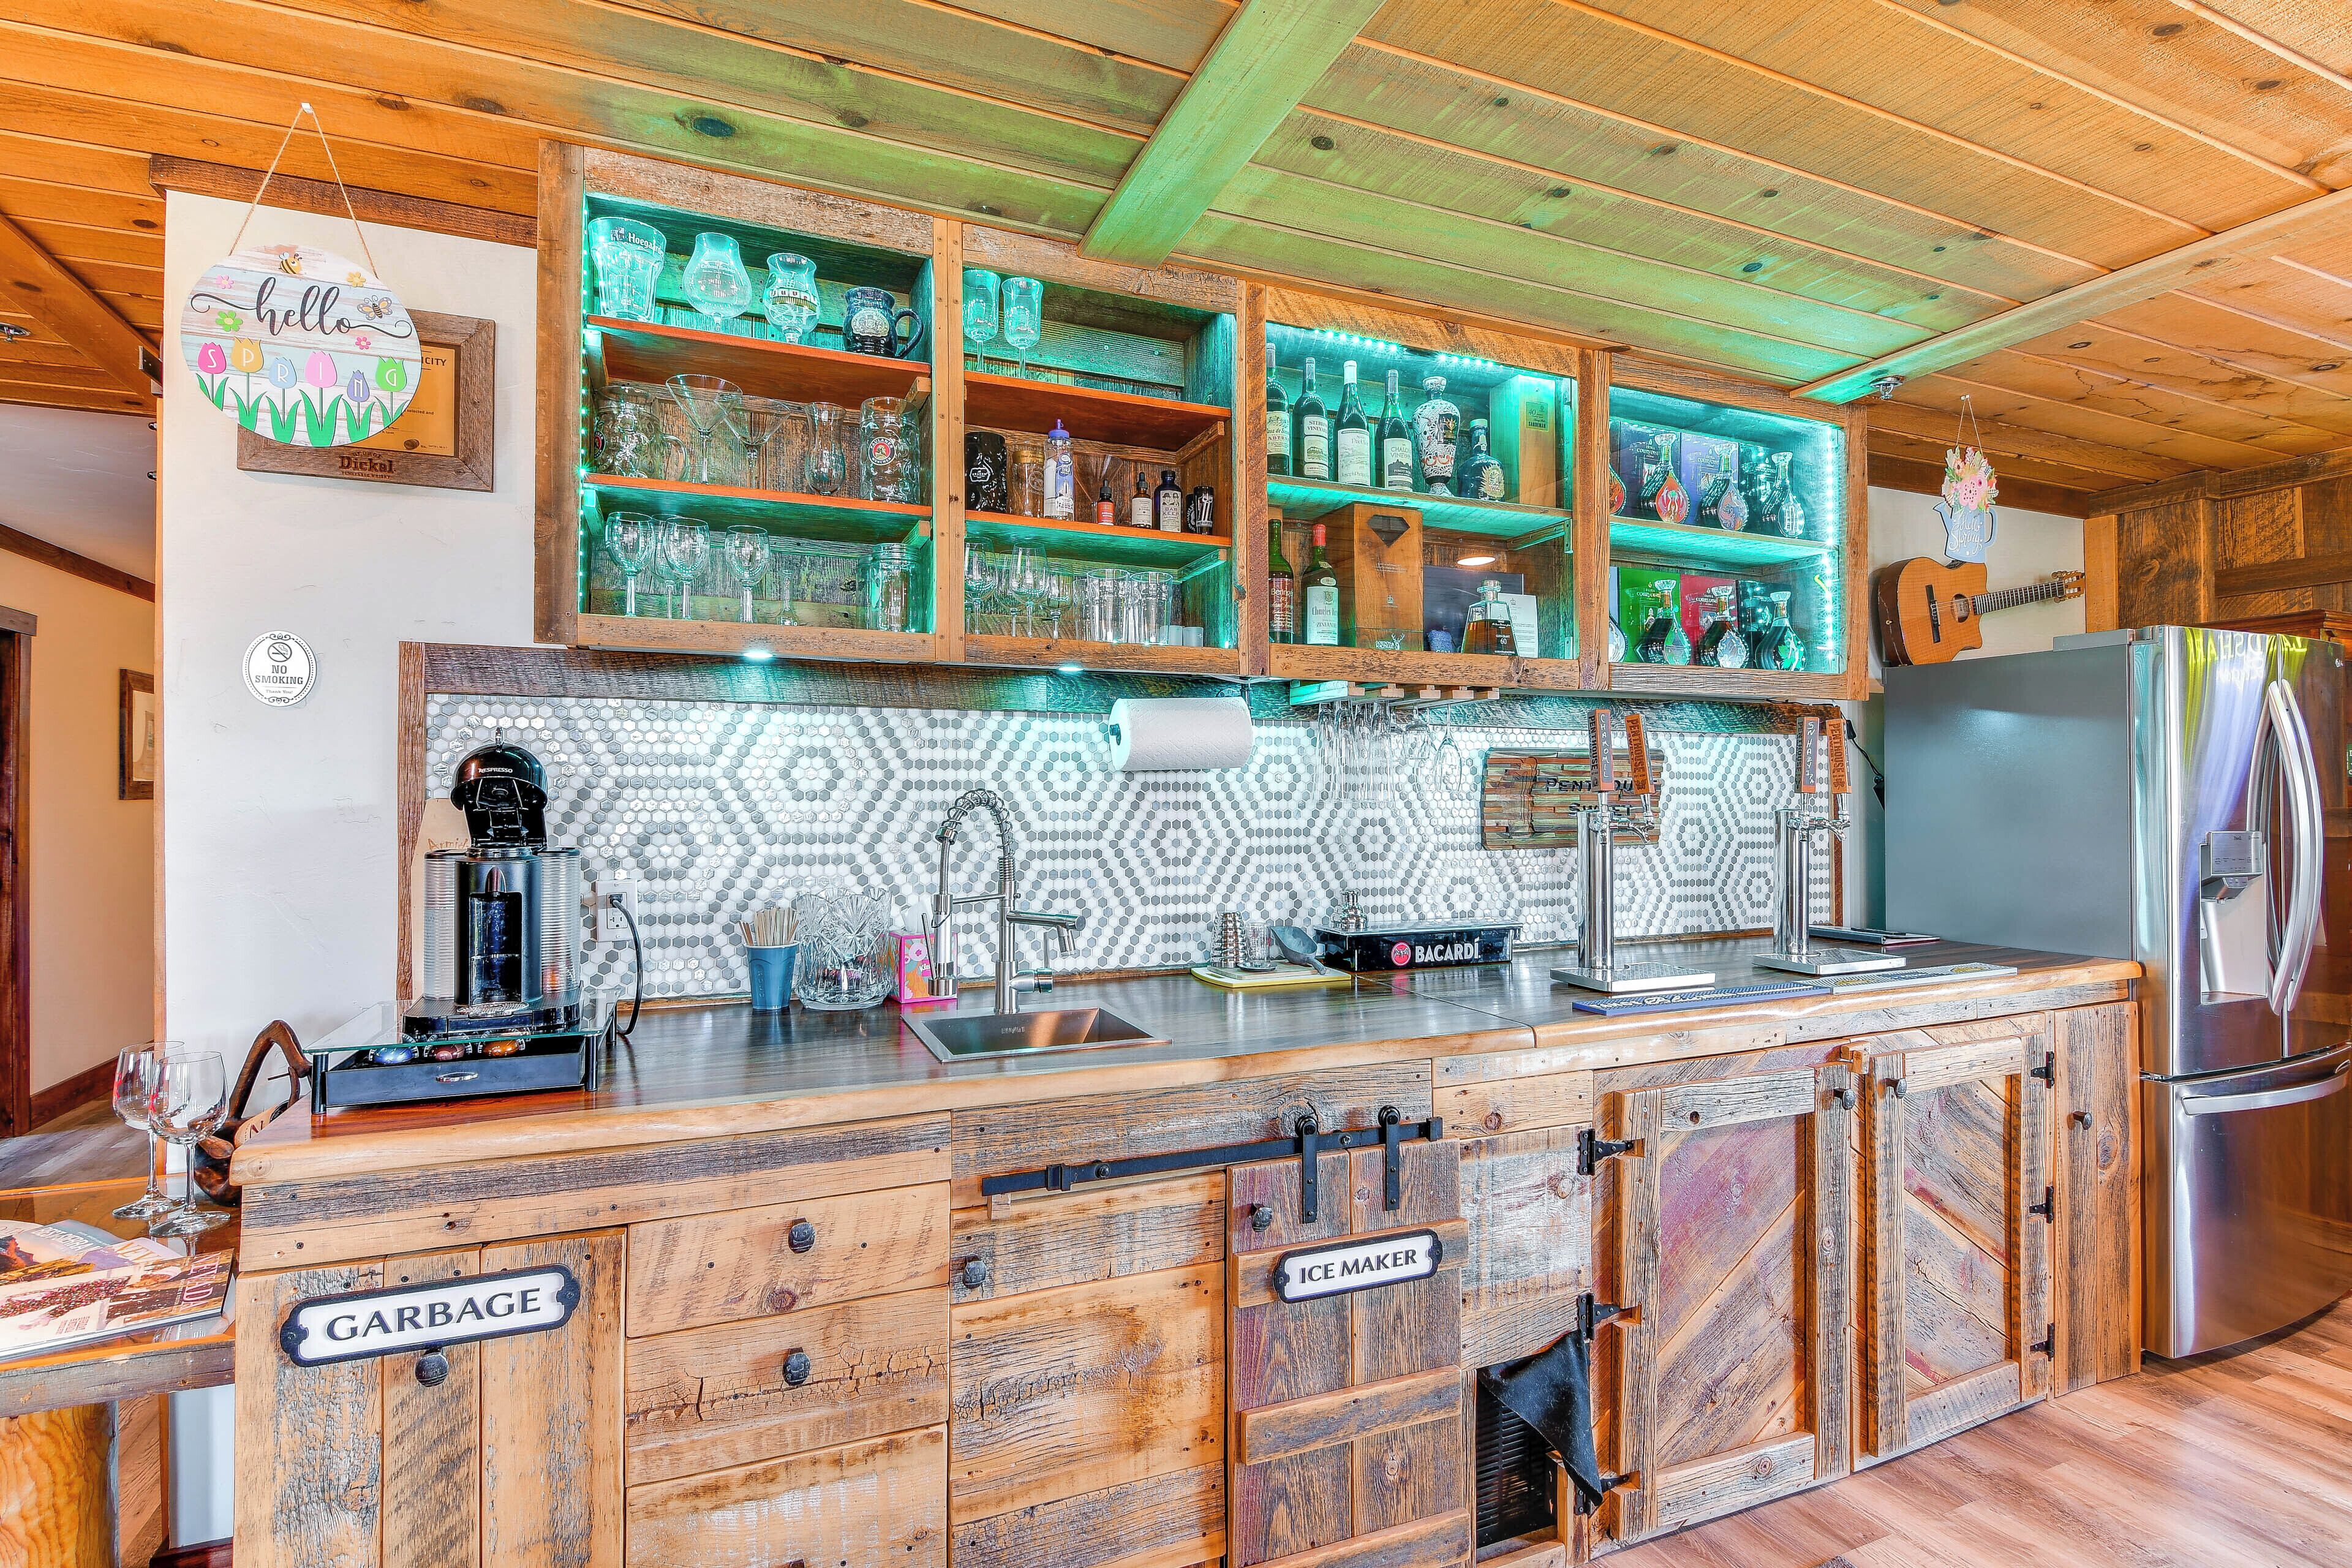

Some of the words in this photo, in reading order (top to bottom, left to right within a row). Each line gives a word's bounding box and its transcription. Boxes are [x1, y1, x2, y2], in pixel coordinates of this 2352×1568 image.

[207, 347, 397, 398] SPRING
[1948, 524, 1983, 554] Spring
[1958, 513, 1980, 532] Hello
[255, 676, 304, 685] SMOKING
[271, 665, 287, 674] NO
[1589, 715, 1598, 771] PENTHOUSE
[1627, 718, 1645, 774] PENTHOUSE
[1829, 723, 1845, 774] PENTHOUSE
[181, 1252, 222, 1311] NEVADA
[1298, 1262, 1335, 1284] ICE
[1341, 1249, 1417, 1277] MAKER
[326, 1287, 541, 1341] GARBAGE
